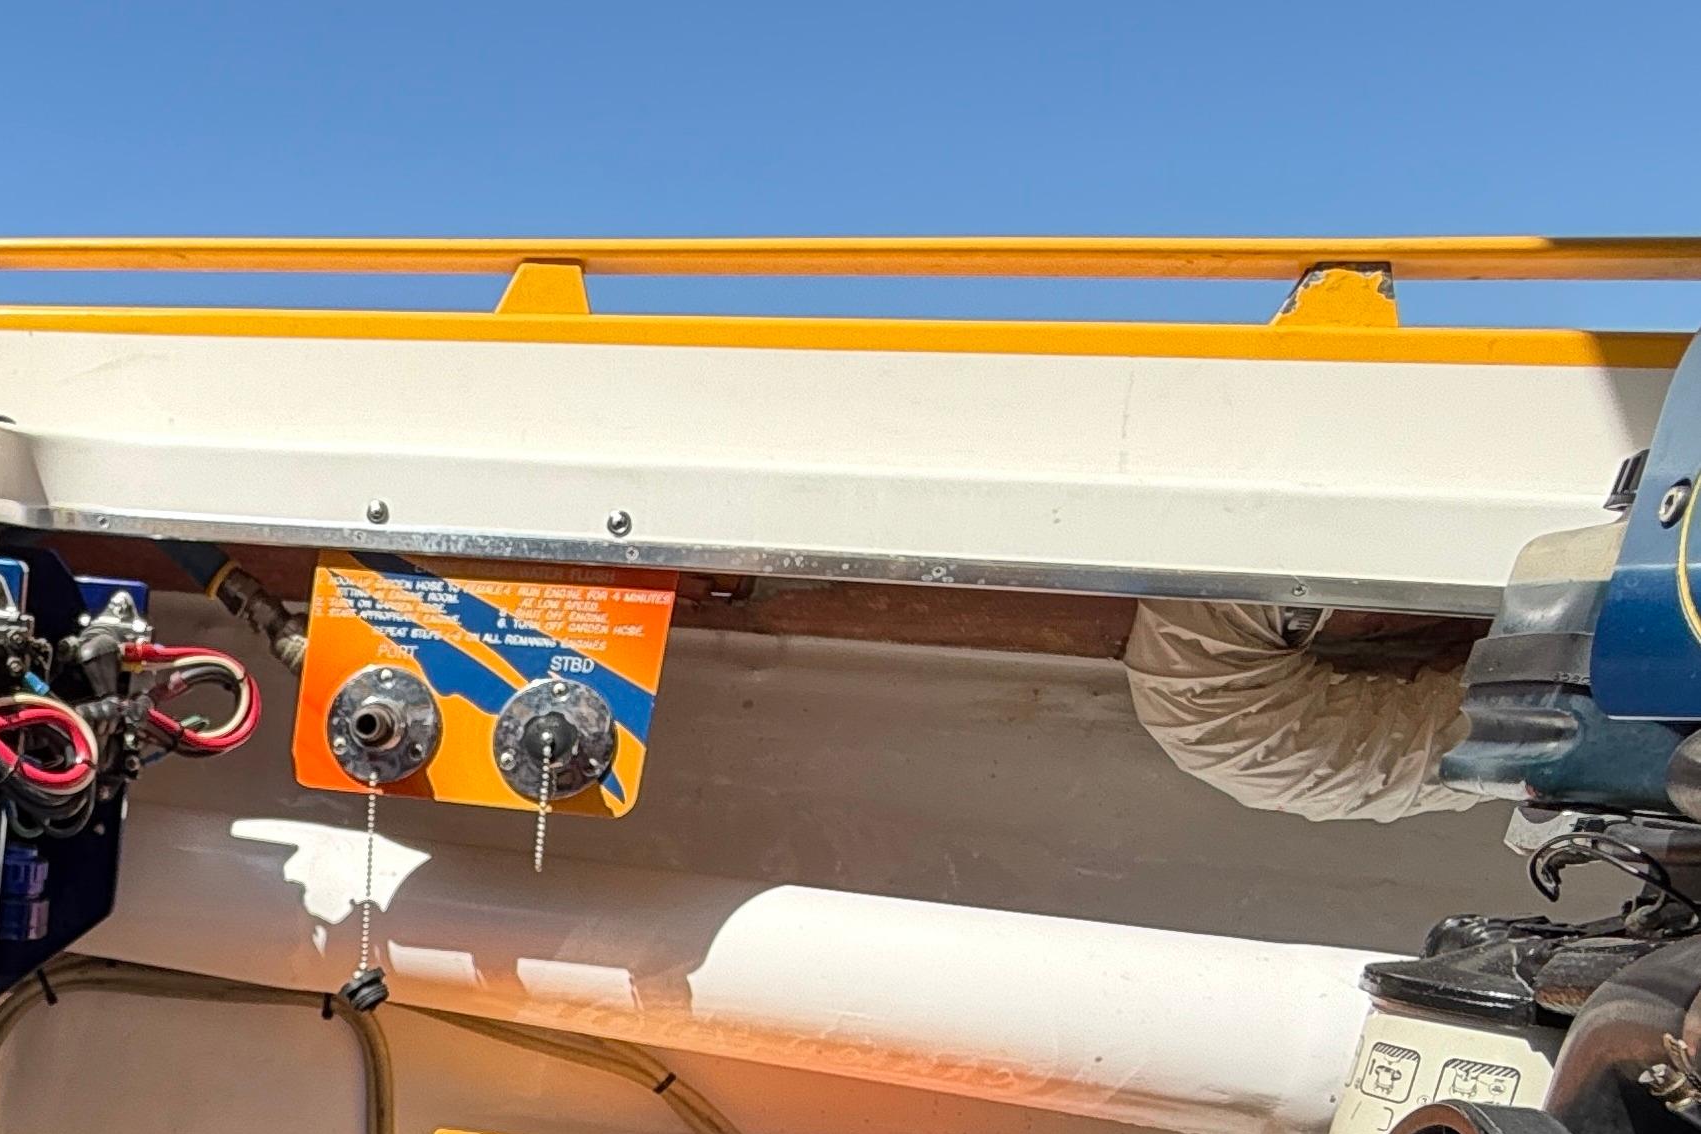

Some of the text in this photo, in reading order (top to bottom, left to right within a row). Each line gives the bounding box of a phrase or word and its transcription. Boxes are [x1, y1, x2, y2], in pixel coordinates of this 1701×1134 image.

[482, 633, 502, 645] ALL
[377, 643, 419, 659] PORT
[549, 655, 595, 674] STBD
